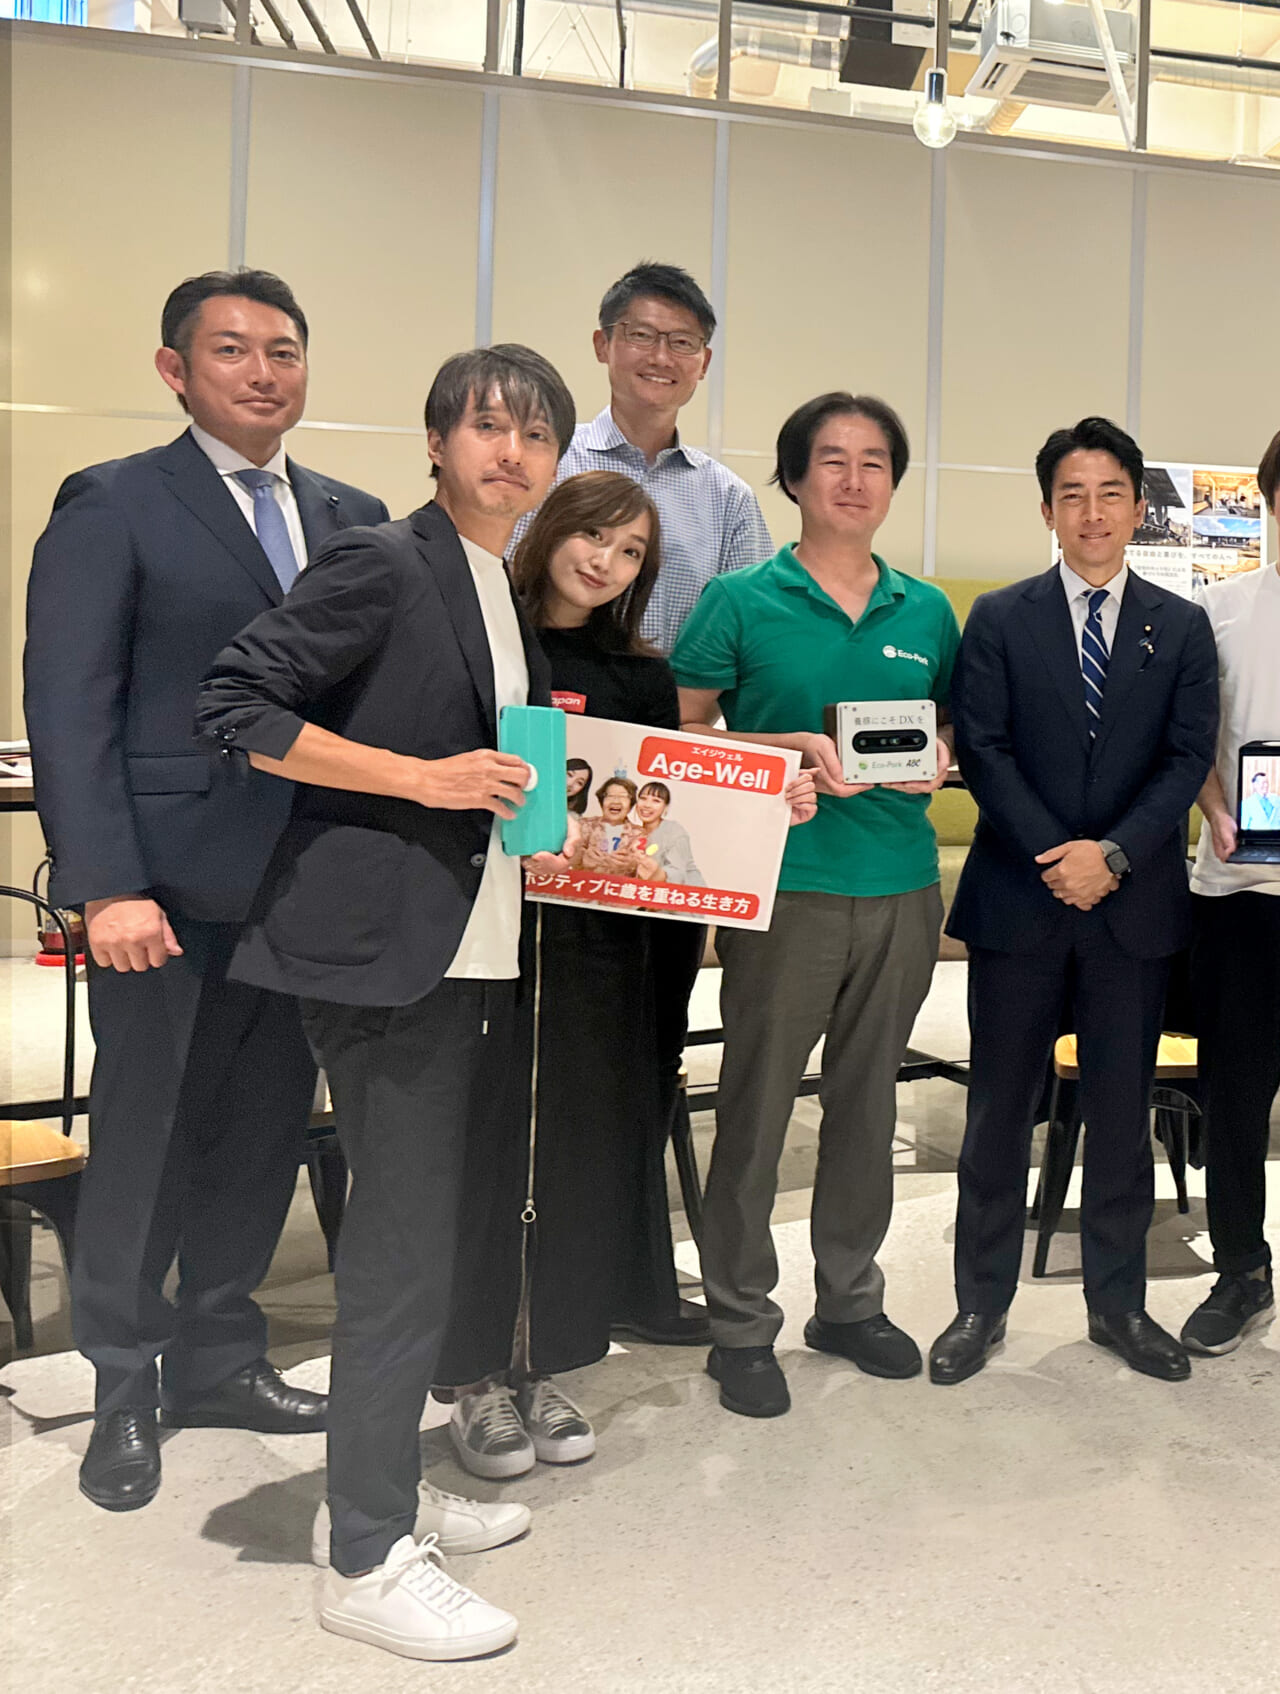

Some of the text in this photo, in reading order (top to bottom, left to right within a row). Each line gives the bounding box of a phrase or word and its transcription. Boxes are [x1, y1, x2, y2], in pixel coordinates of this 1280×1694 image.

[1125, 549, 1233, 561] てる自由と喜びを、すべての人へ
[899, 715, 914, 725] DX
[690, 746, 744, 762] エイジウェル
[905, 758, 921, 768] ABC
[648, 752, 771, 791] Age-Well
